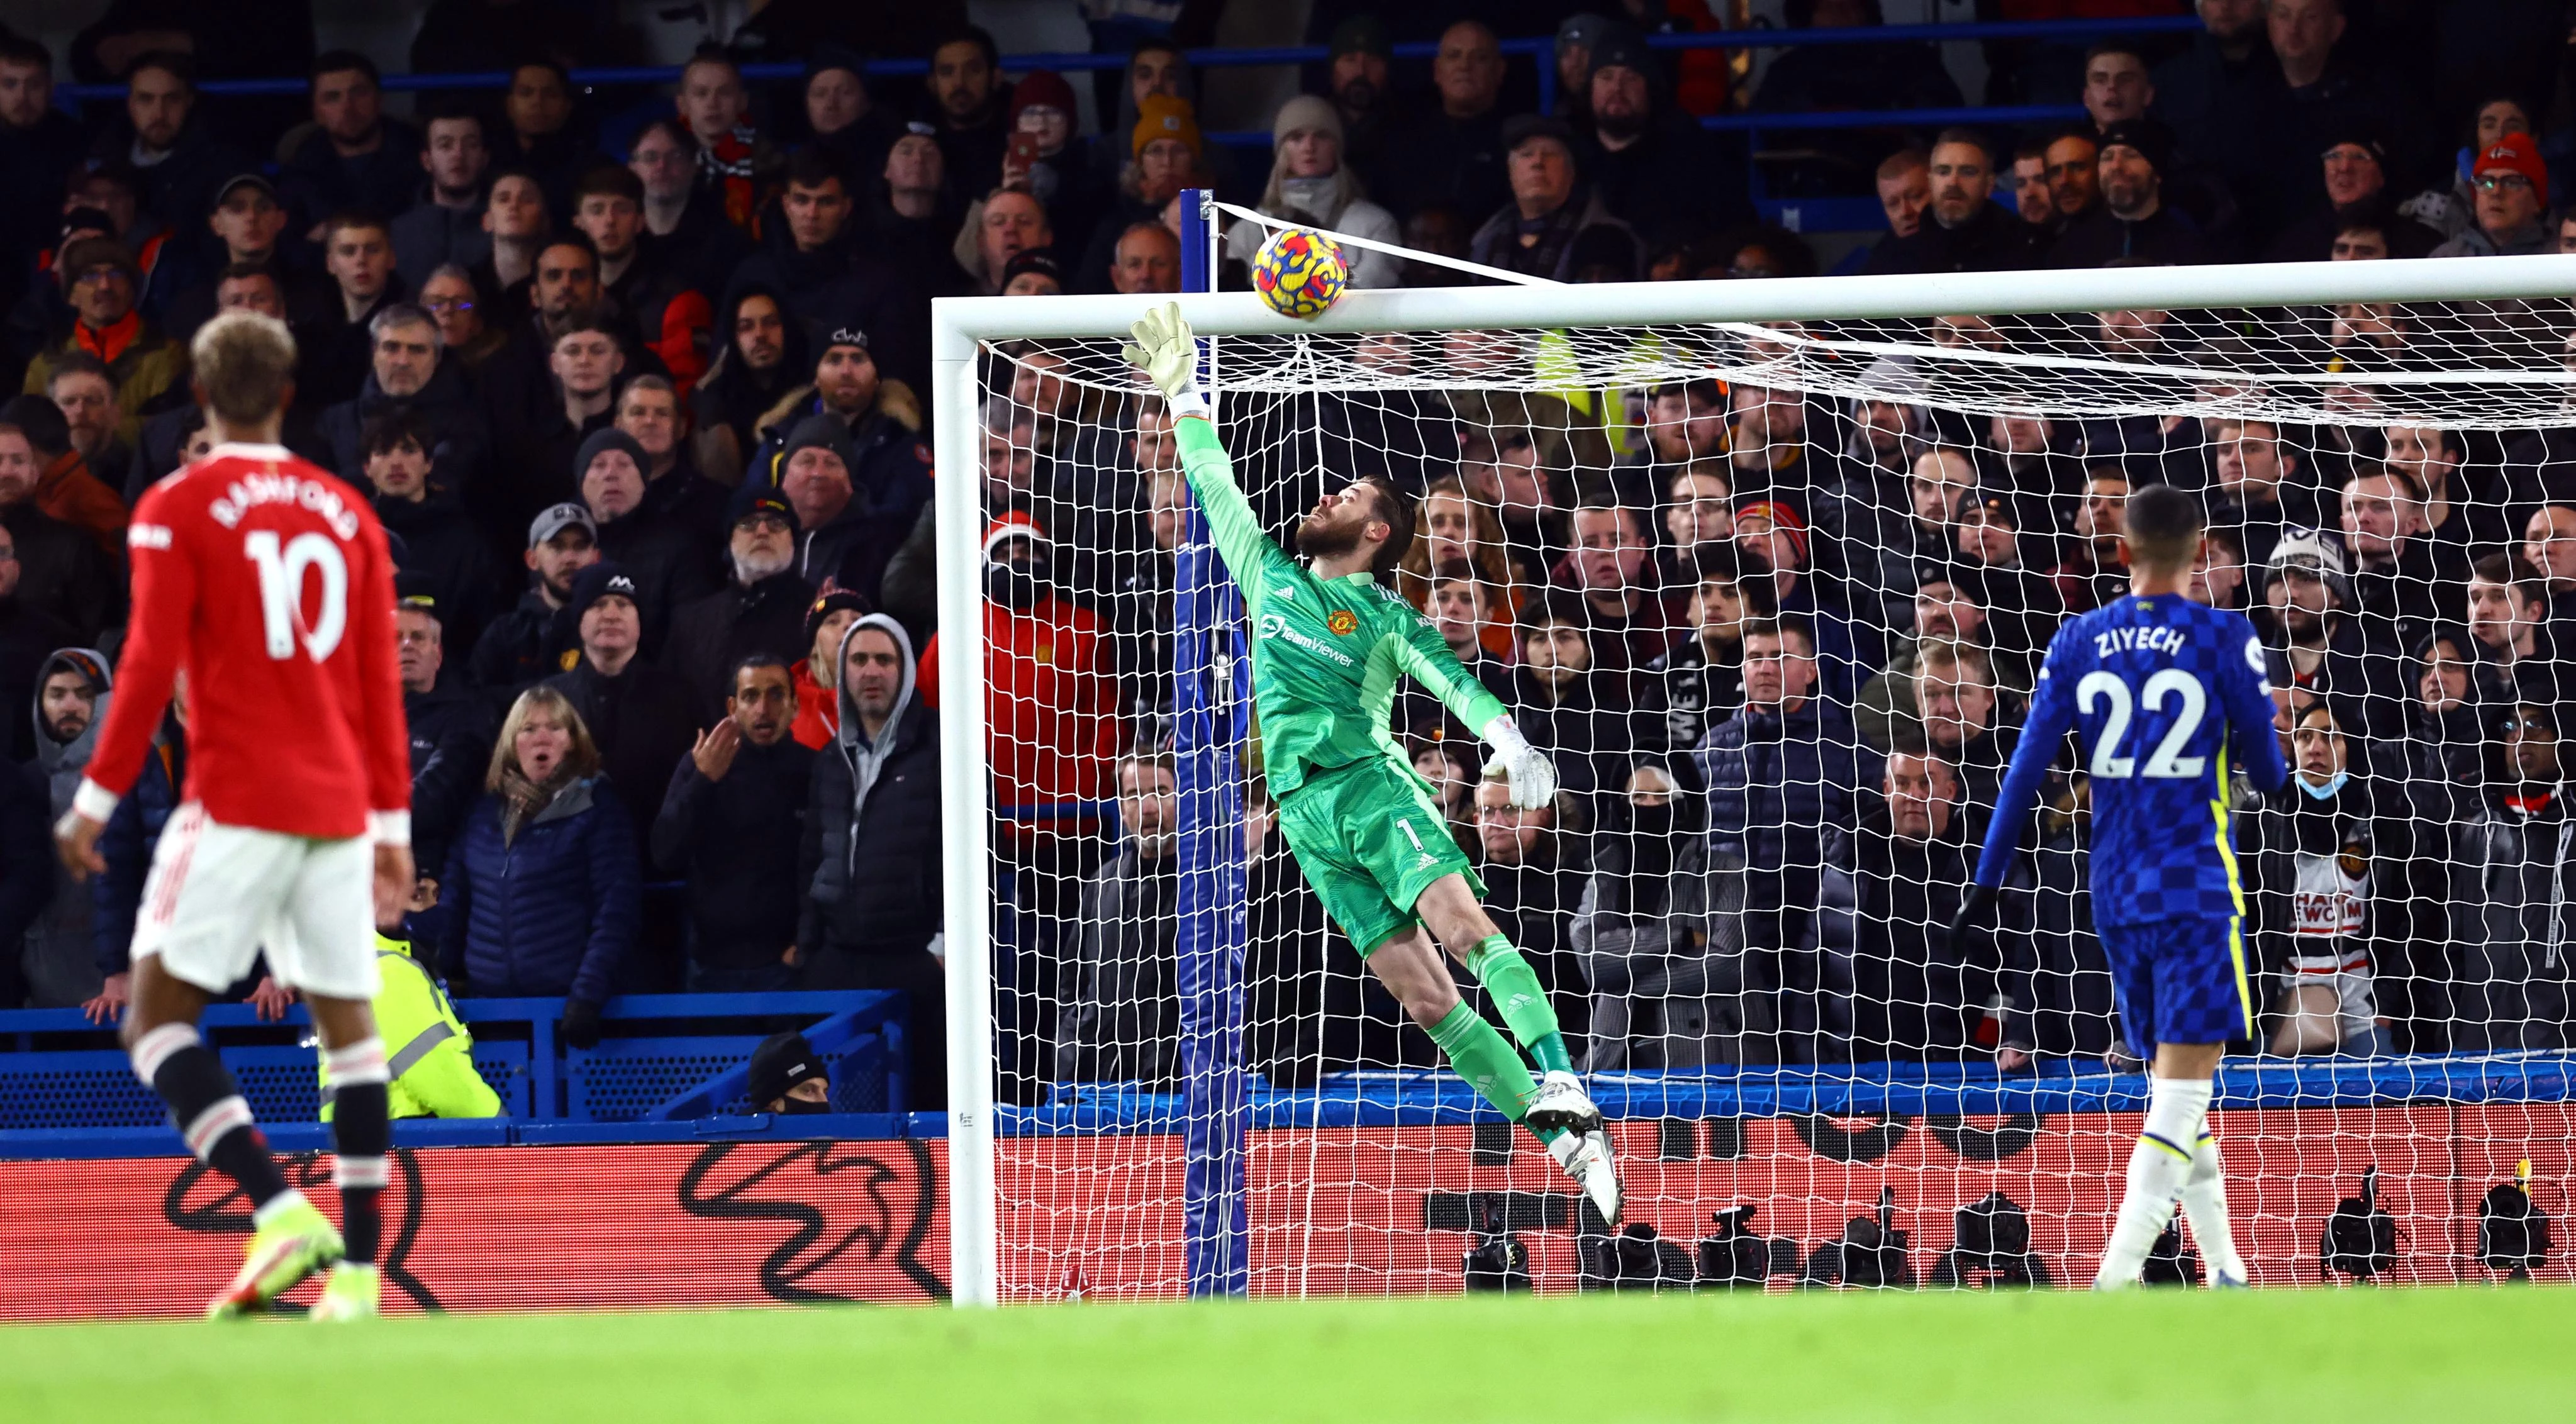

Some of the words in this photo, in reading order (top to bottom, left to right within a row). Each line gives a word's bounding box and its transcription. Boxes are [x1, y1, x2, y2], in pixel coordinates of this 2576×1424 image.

[209, 472, 358, 540] RASHFORD
[245, 531, 348, 664] 10
[1281, 626, 1354, 667] TeamViewer
[2094, 626, 2186, 659] ZIYECH
[2076, 668, 2206, 779] 22
[1397, 818, 1425, 852] 1
